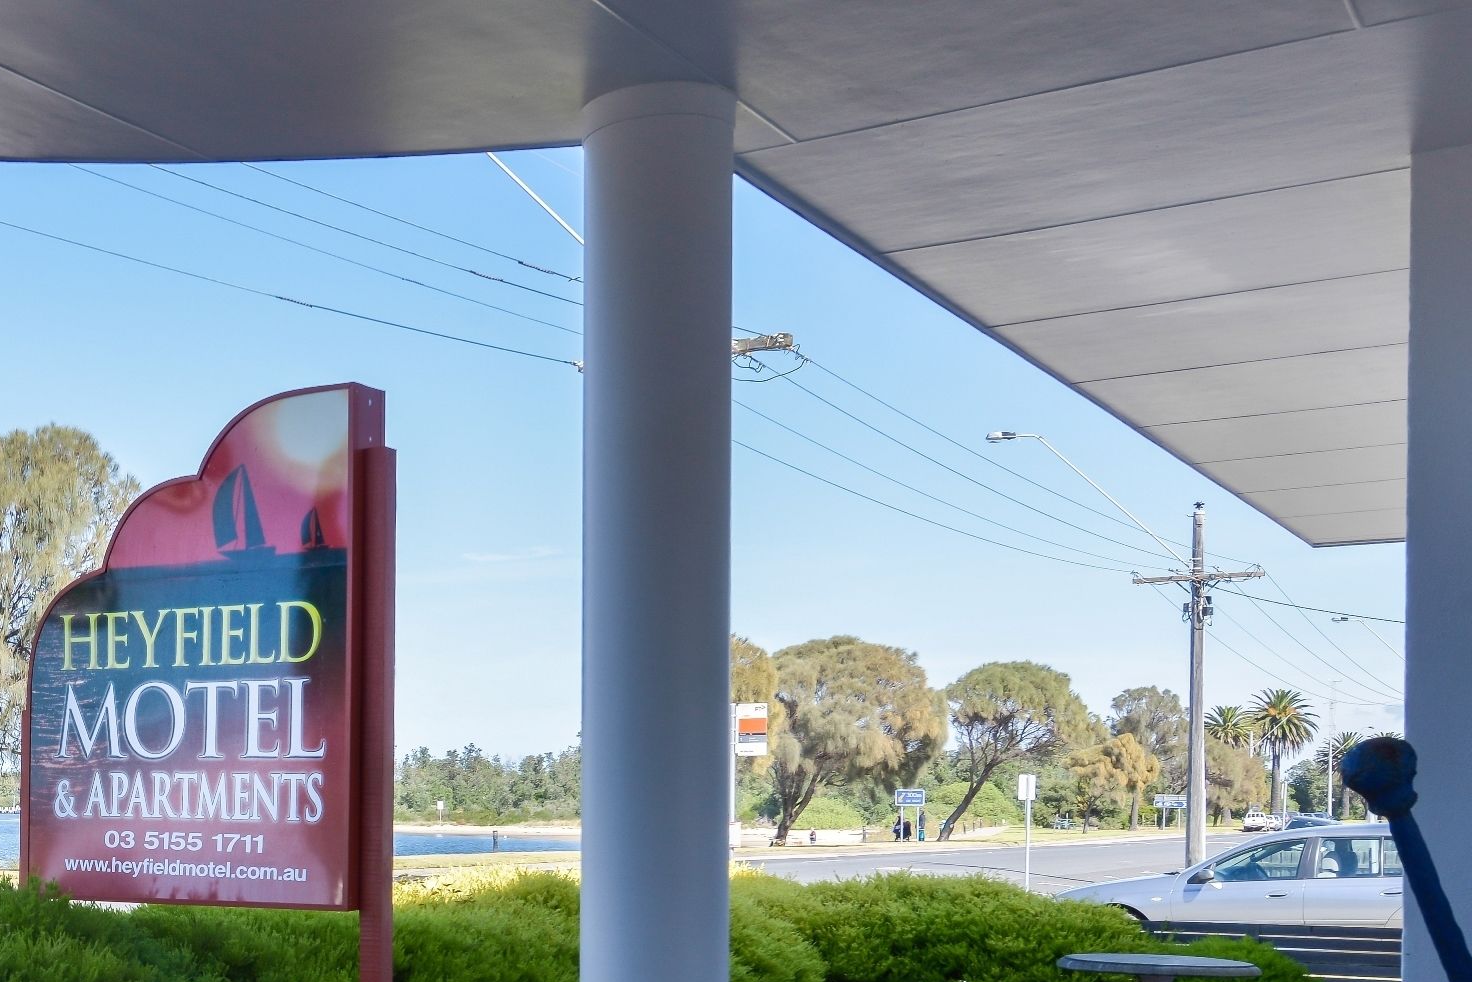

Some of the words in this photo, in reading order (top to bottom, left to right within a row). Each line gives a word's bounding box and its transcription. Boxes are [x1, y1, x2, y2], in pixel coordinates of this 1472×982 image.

[60, 600, 322, 670] HEYFIELD
[53, 677, 325, 758] MOTEL
[53, 779, 77, 818] &
[83, 771, 324, 823] APARTMENTS
[104, 830, 136, 849] 03
[144, 831, 203, 850] 5155
[211, 834, 265, 854] 1711
[64, 857, 308, 882] www.heyfieldmotel.com.au
